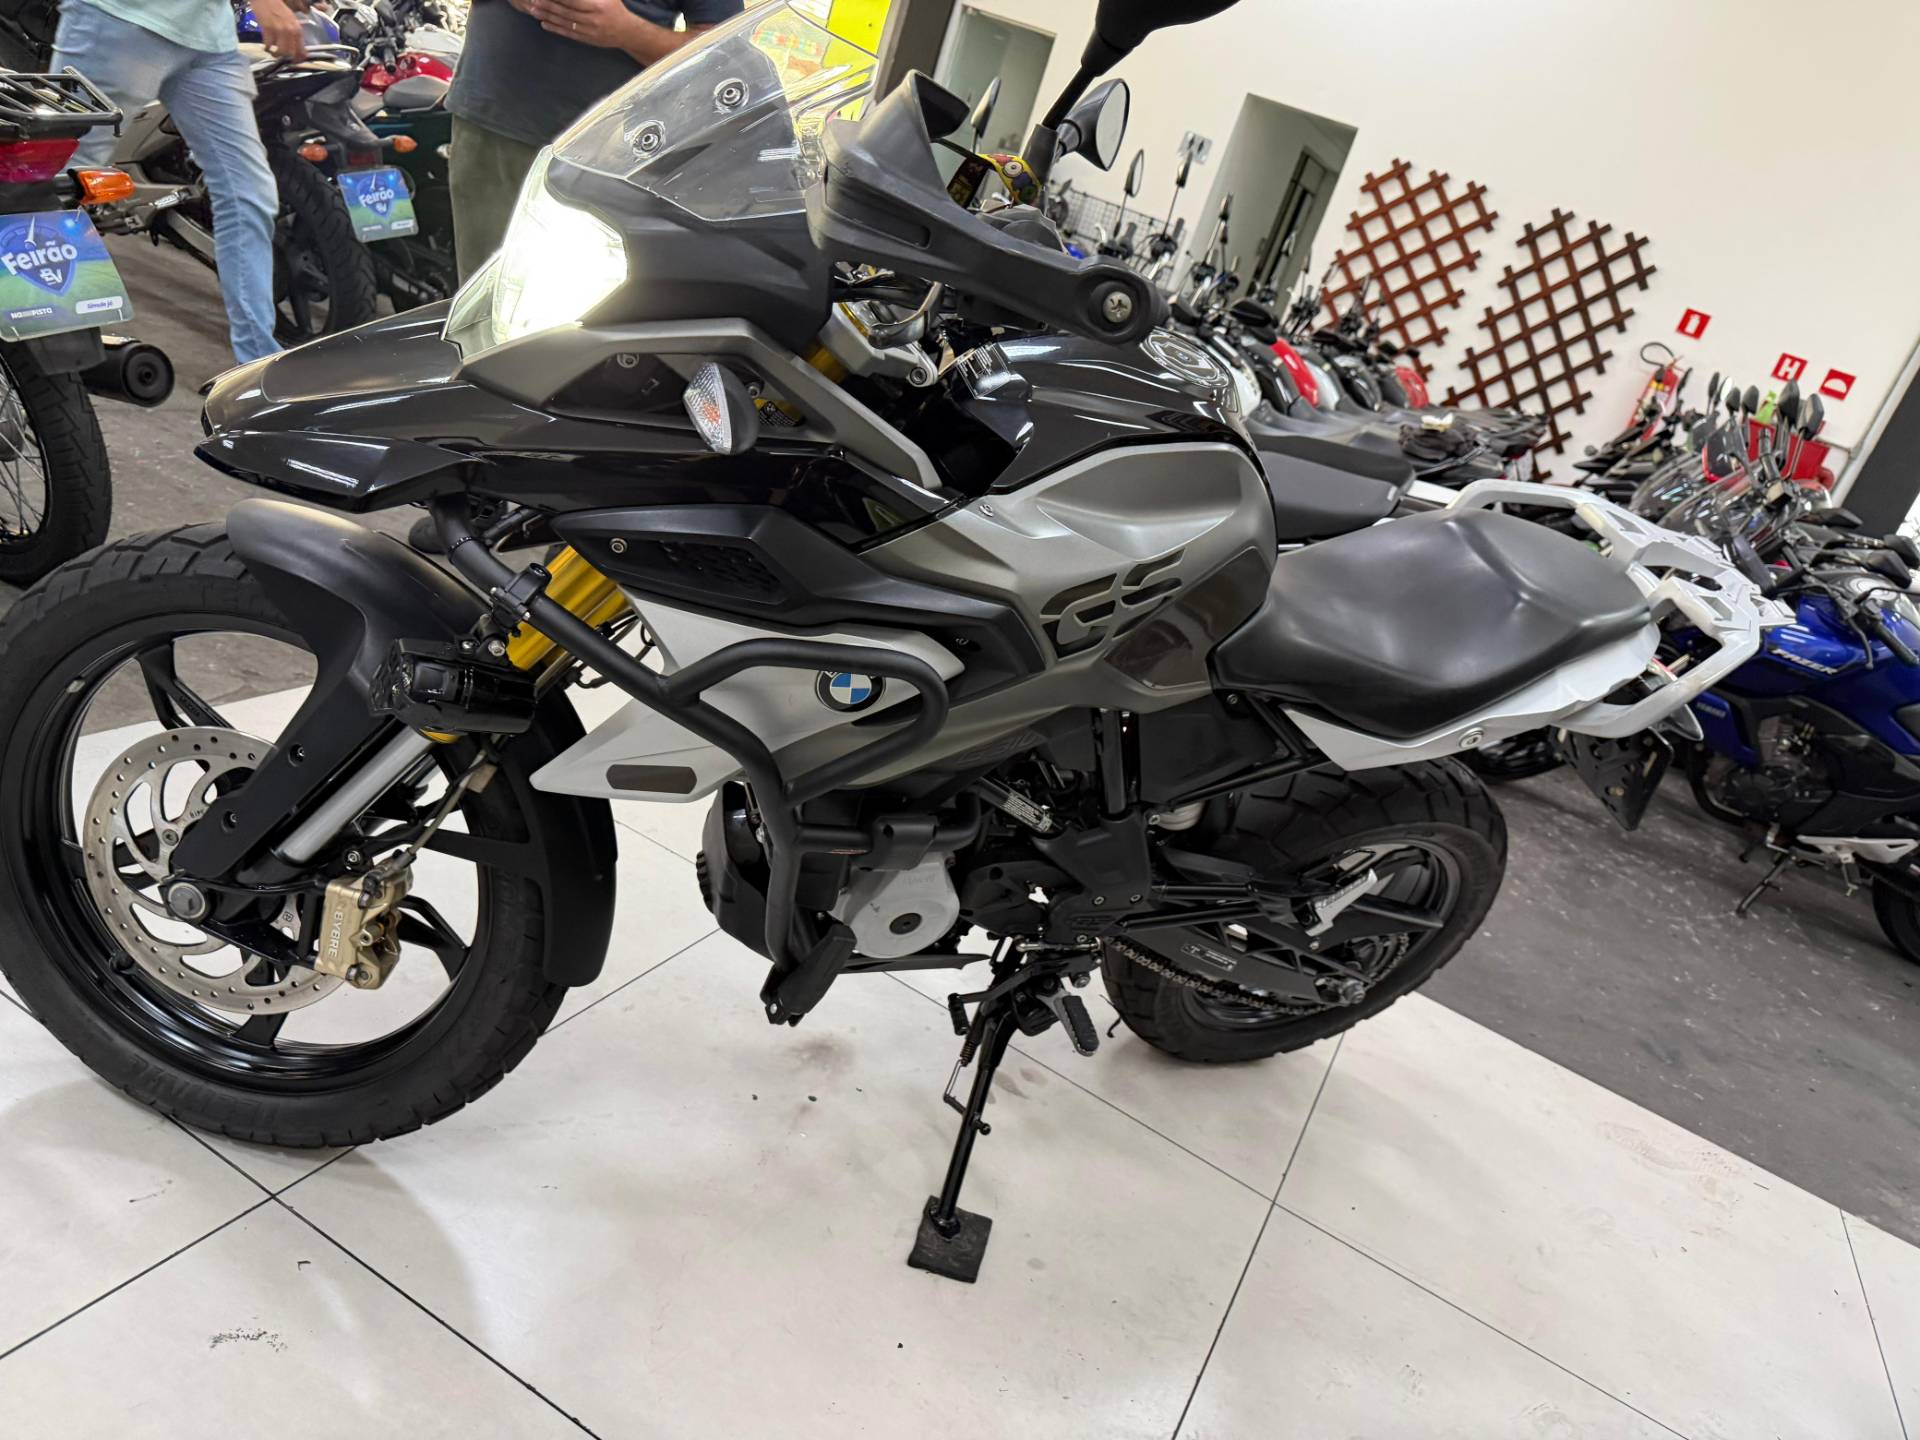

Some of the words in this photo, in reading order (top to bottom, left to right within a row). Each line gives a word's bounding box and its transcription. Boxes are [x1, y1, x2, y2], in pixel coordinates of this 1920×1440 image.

[359, 187, 394, 207] Feirão
[1, 240, 78, 276] Feirão
[1041, 547, 1185, 660] GS
[329, 911, 343, 957] BYBRE
